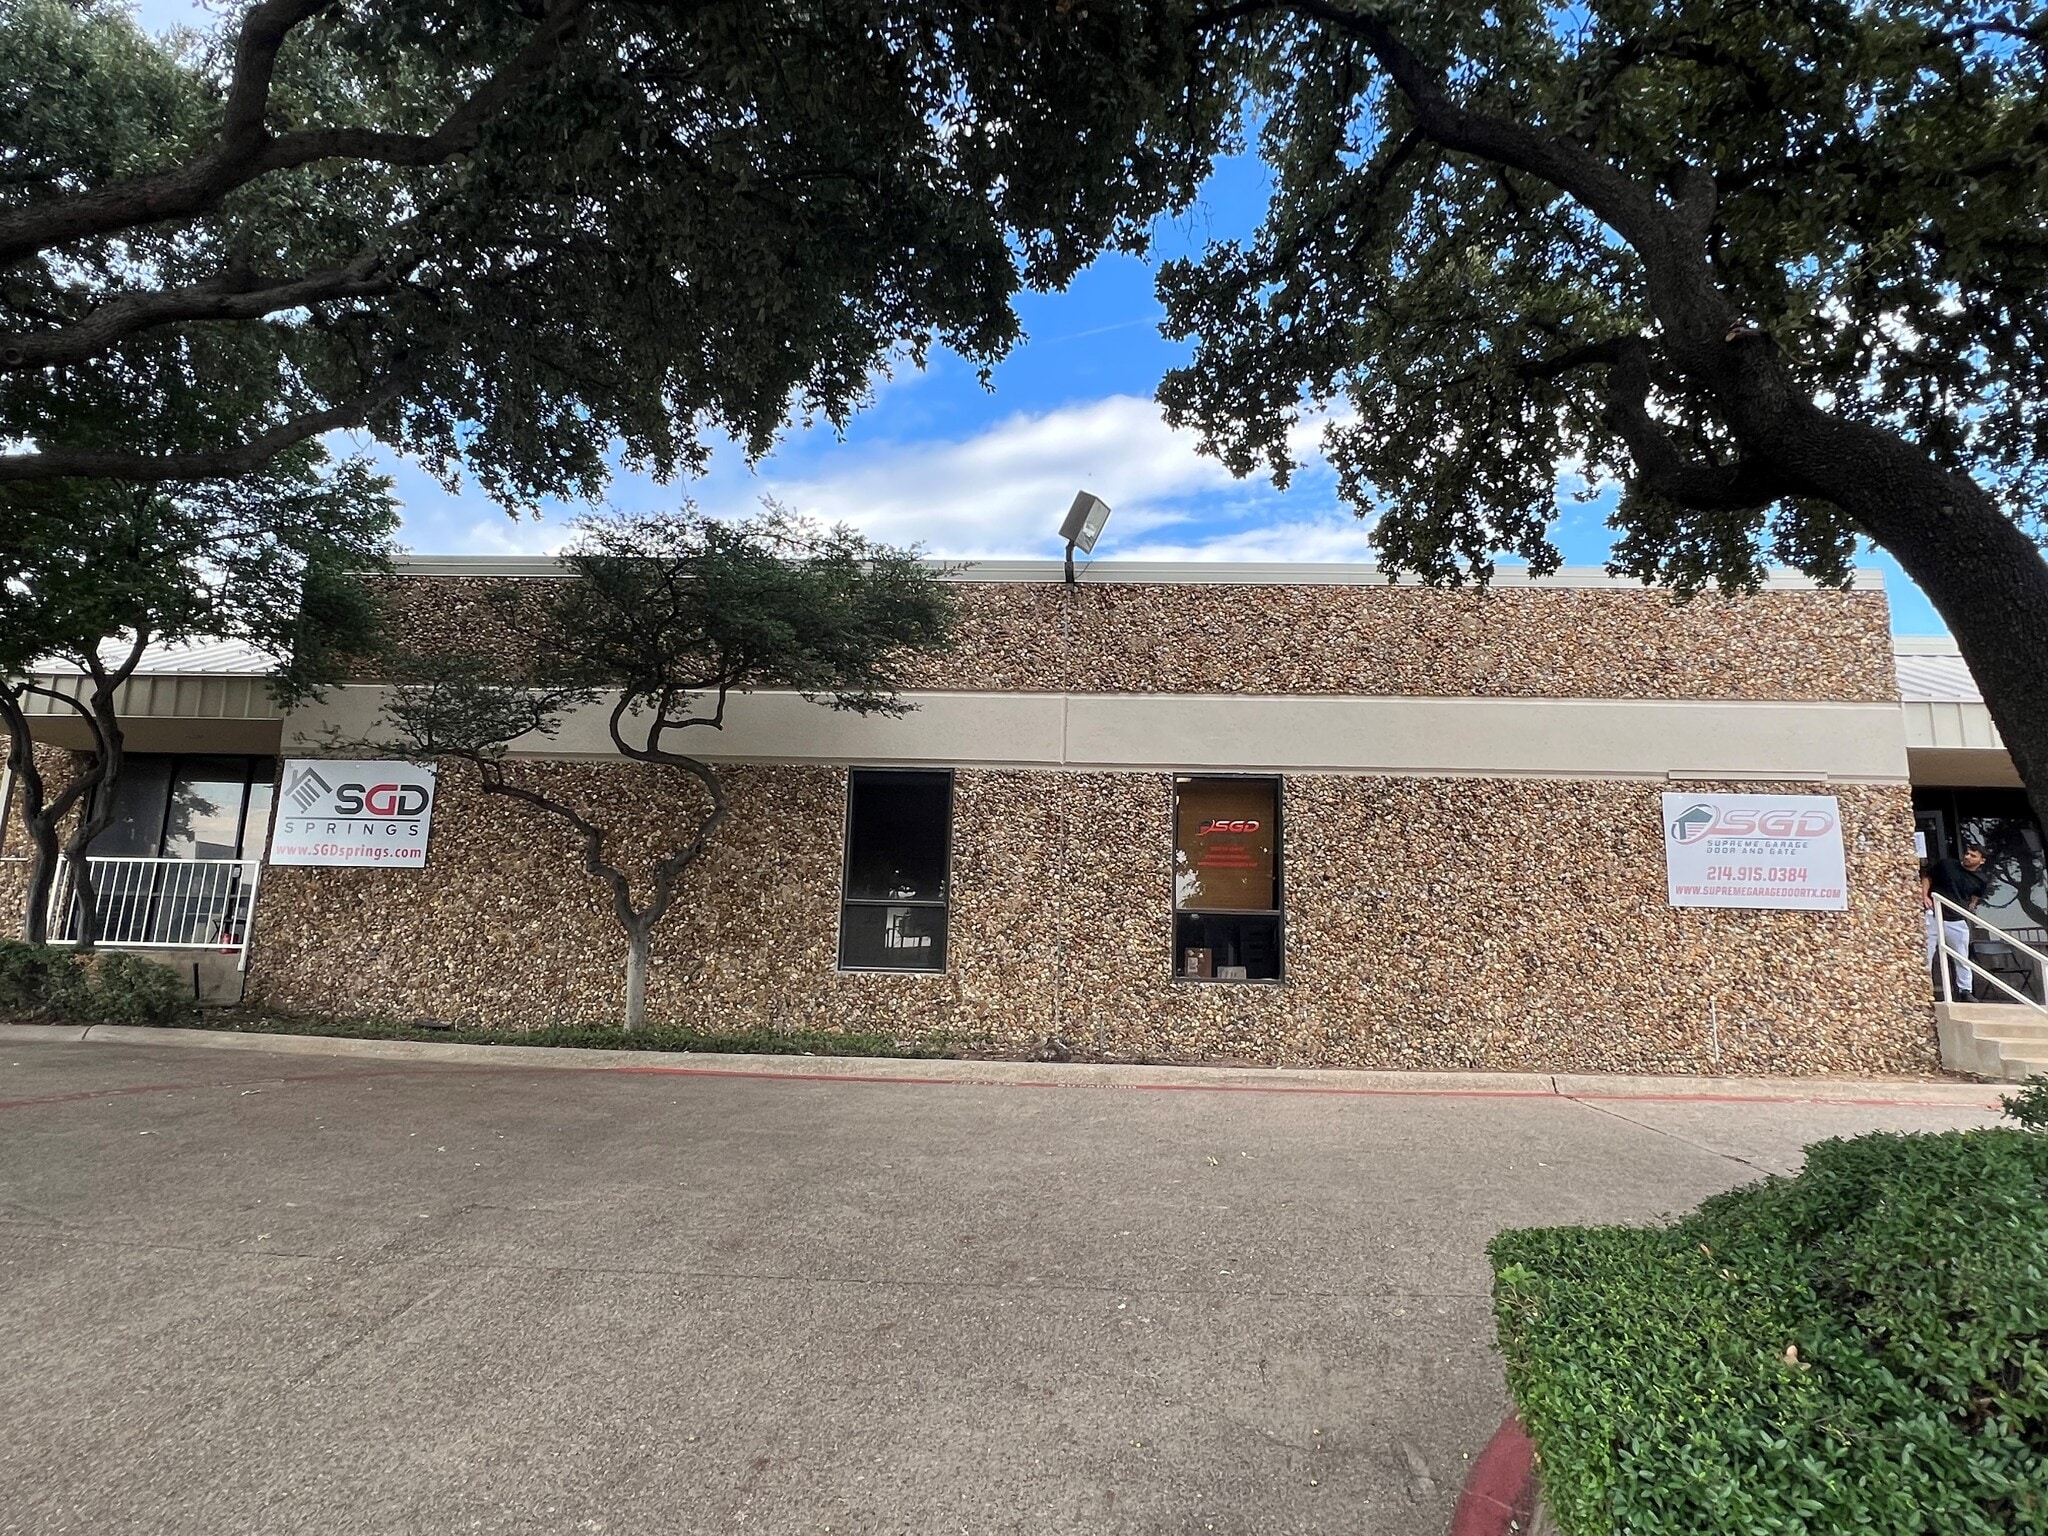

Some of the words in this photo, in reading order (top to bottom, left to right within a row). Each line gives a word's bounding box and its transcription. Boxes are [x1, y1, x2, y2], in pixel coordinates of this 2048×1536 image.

[335, 783, 429, 815] SGD
[284, 822, 418, 836] SPRINGS
[1211, 820, 1260, 832] SGD
[1710, 809, 1834, 837] SGD
[276, 844, 422, 861] www.SGDsprings.com
[1741, 847, 1763, 855] AND
[1770, 848, 1797, 856] GATE
[1706, 866, 1808, 882] 214.915.0384
[1675, 885, 1841, 899] WWW.SUPREMEGARAGEDOORTX.COM
